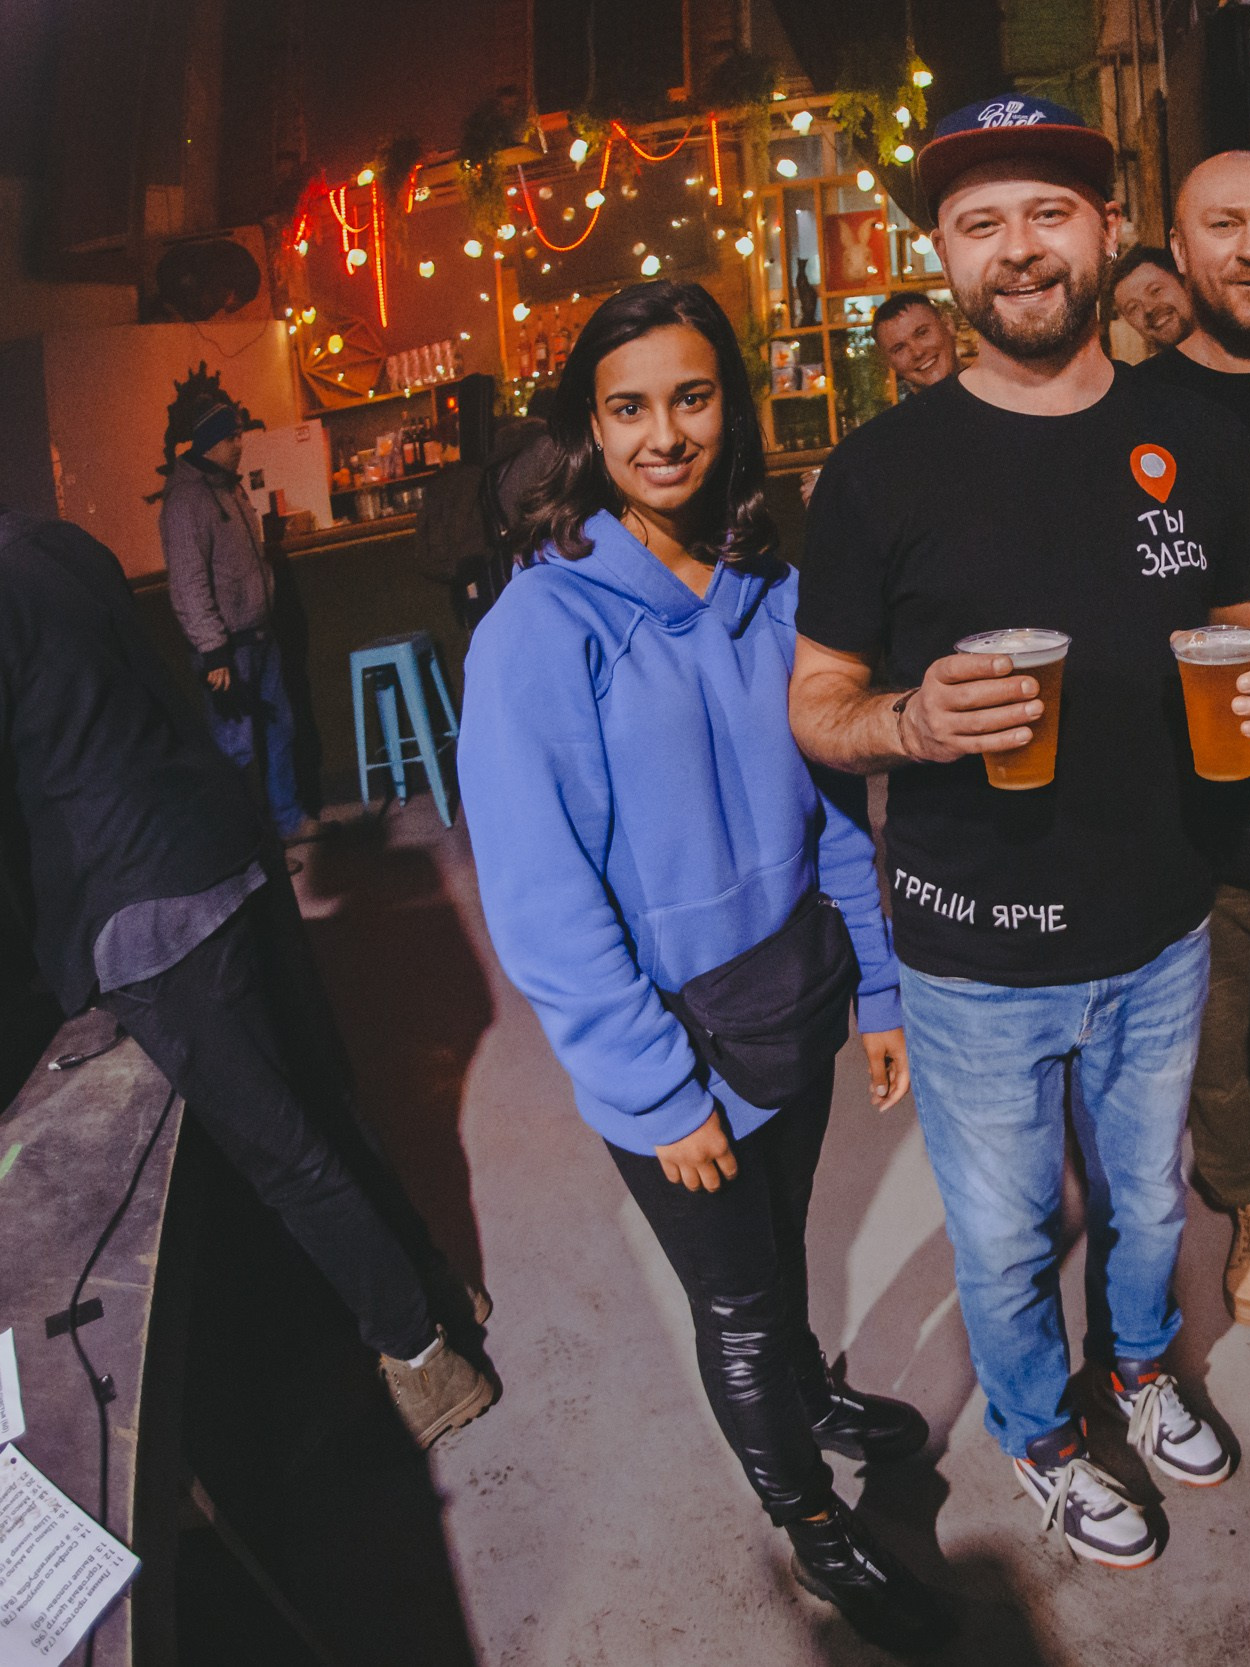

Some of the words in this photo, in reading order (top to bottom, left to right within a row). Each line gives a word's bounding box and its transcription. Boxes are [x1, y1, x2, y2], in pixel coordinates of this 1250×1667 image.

[1138, 509, 1184, 536] ТЫ
[1136, 540, 1208, 578] ЗДЕСЬ
[992, 904, 1068, 933] ЯРЧЕ
[53, 1541, 79, 1568] Селфи
[72, 1554, 95, 1580] Выше
[45, 1568, 54, 1579] со
[46, 1580, 72, 1612] головы
[31, 1612, 47, 1631] (60)
[47, 1603, 68, 1629] центр
[55, 1597, 88, 1636] протеста
[40, 1636, 56, 1655] (74)
